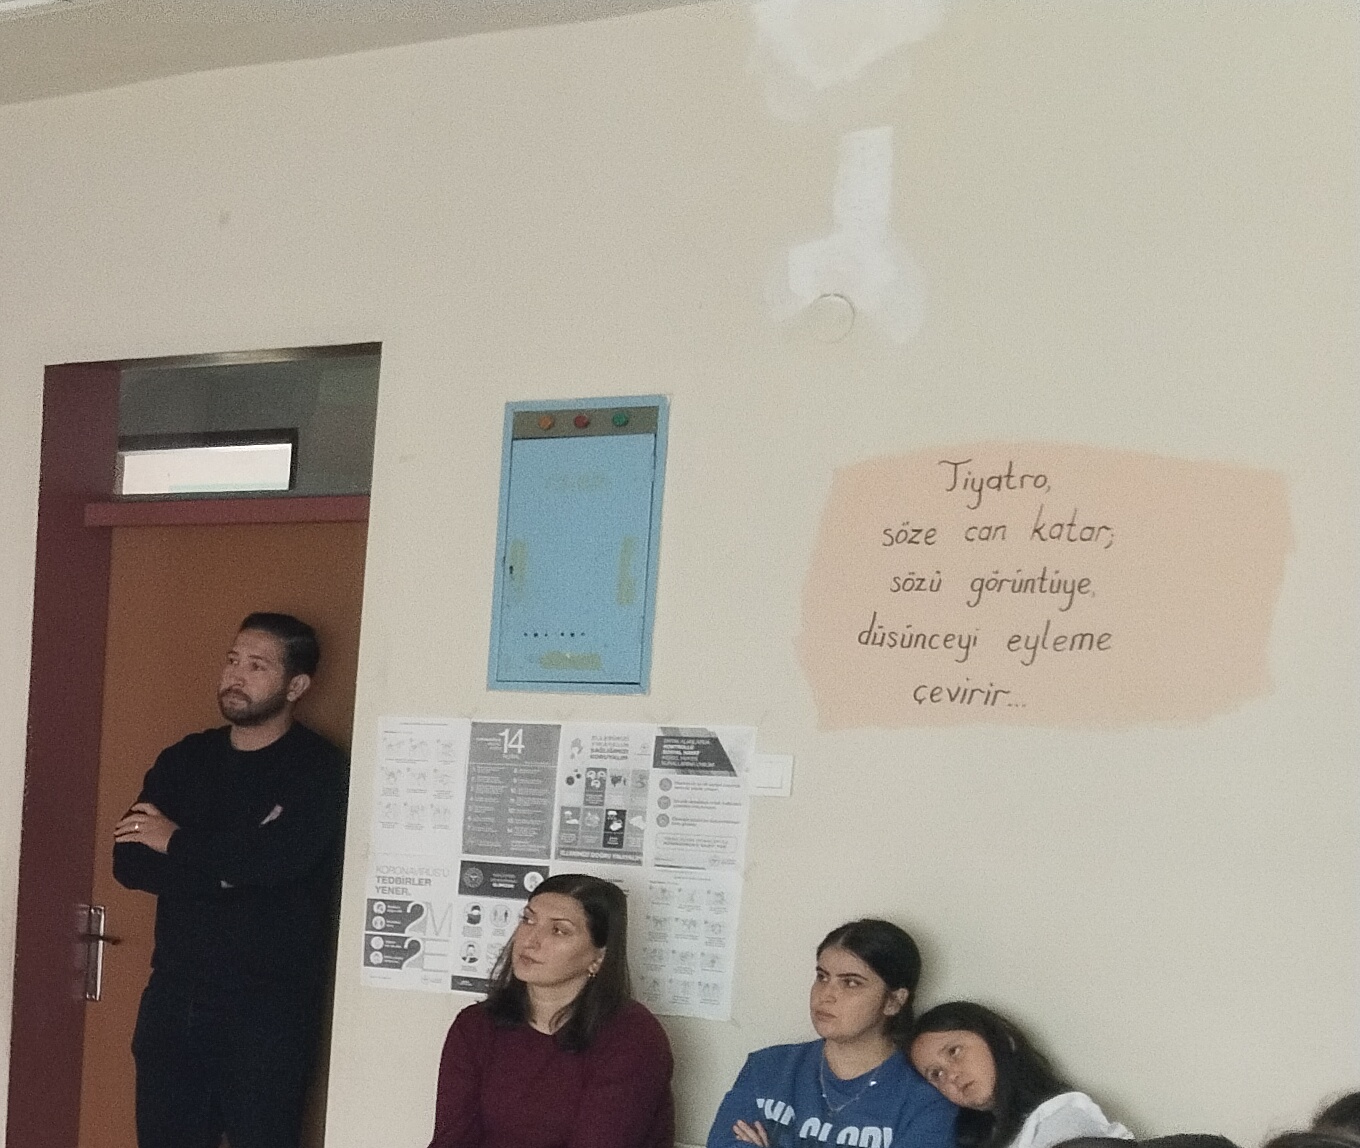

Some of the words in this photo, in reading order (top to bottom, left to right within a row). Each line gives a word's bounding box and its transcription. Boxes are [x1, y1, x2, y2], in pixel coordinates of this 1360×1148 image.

[937, 457, 1052, 511] Tiyatro,
[881, 520, 938, 547] söze
[963, 524, 1008, 543] can
[1029, 503, 1115, 550] katar;
[889, 569, 943, 594] sözü
[1005, 619, 1114, 667] eyleme
[498, 728, 525, 754] 14
